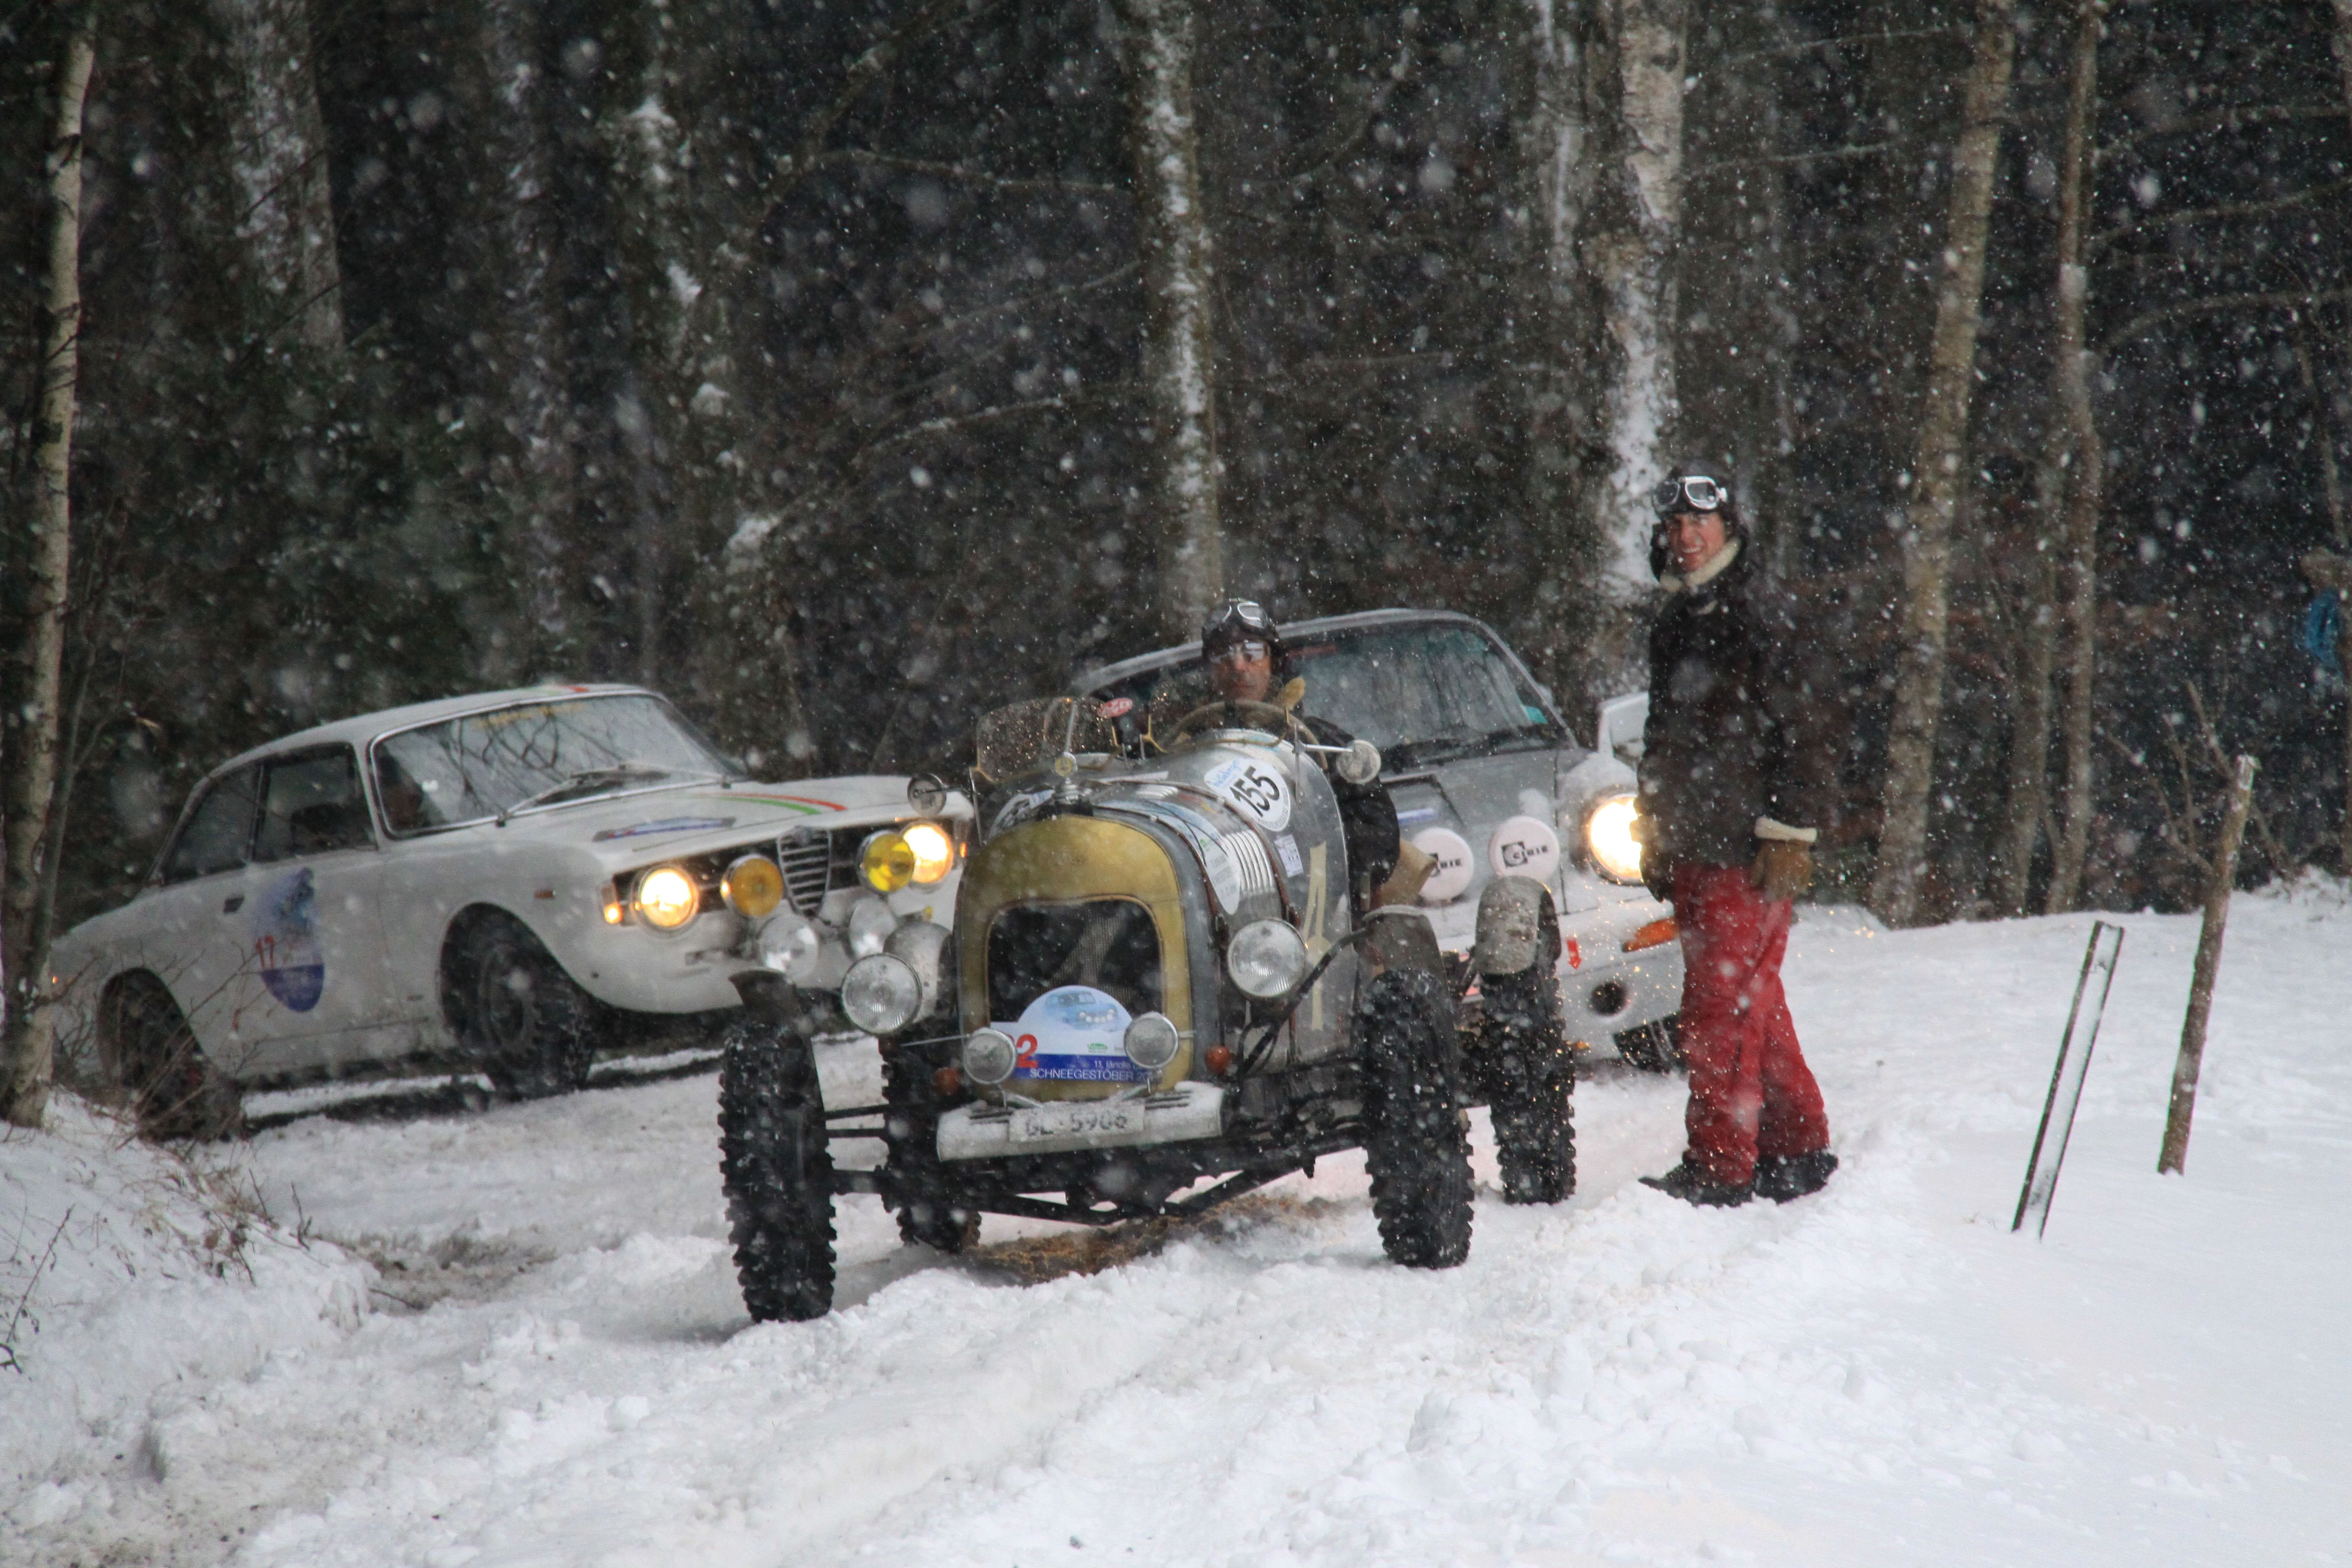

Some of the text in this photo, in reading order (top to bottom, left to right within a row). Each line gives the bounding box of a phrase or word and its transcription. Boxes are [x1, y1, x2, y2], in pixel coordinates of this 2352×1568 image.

[1229, 765, 1279, 817] 155
[1008, 1033, 1038, 1068] 2
[1029, 1068, 1133, 1081] SCHNEEGESTÖBER
